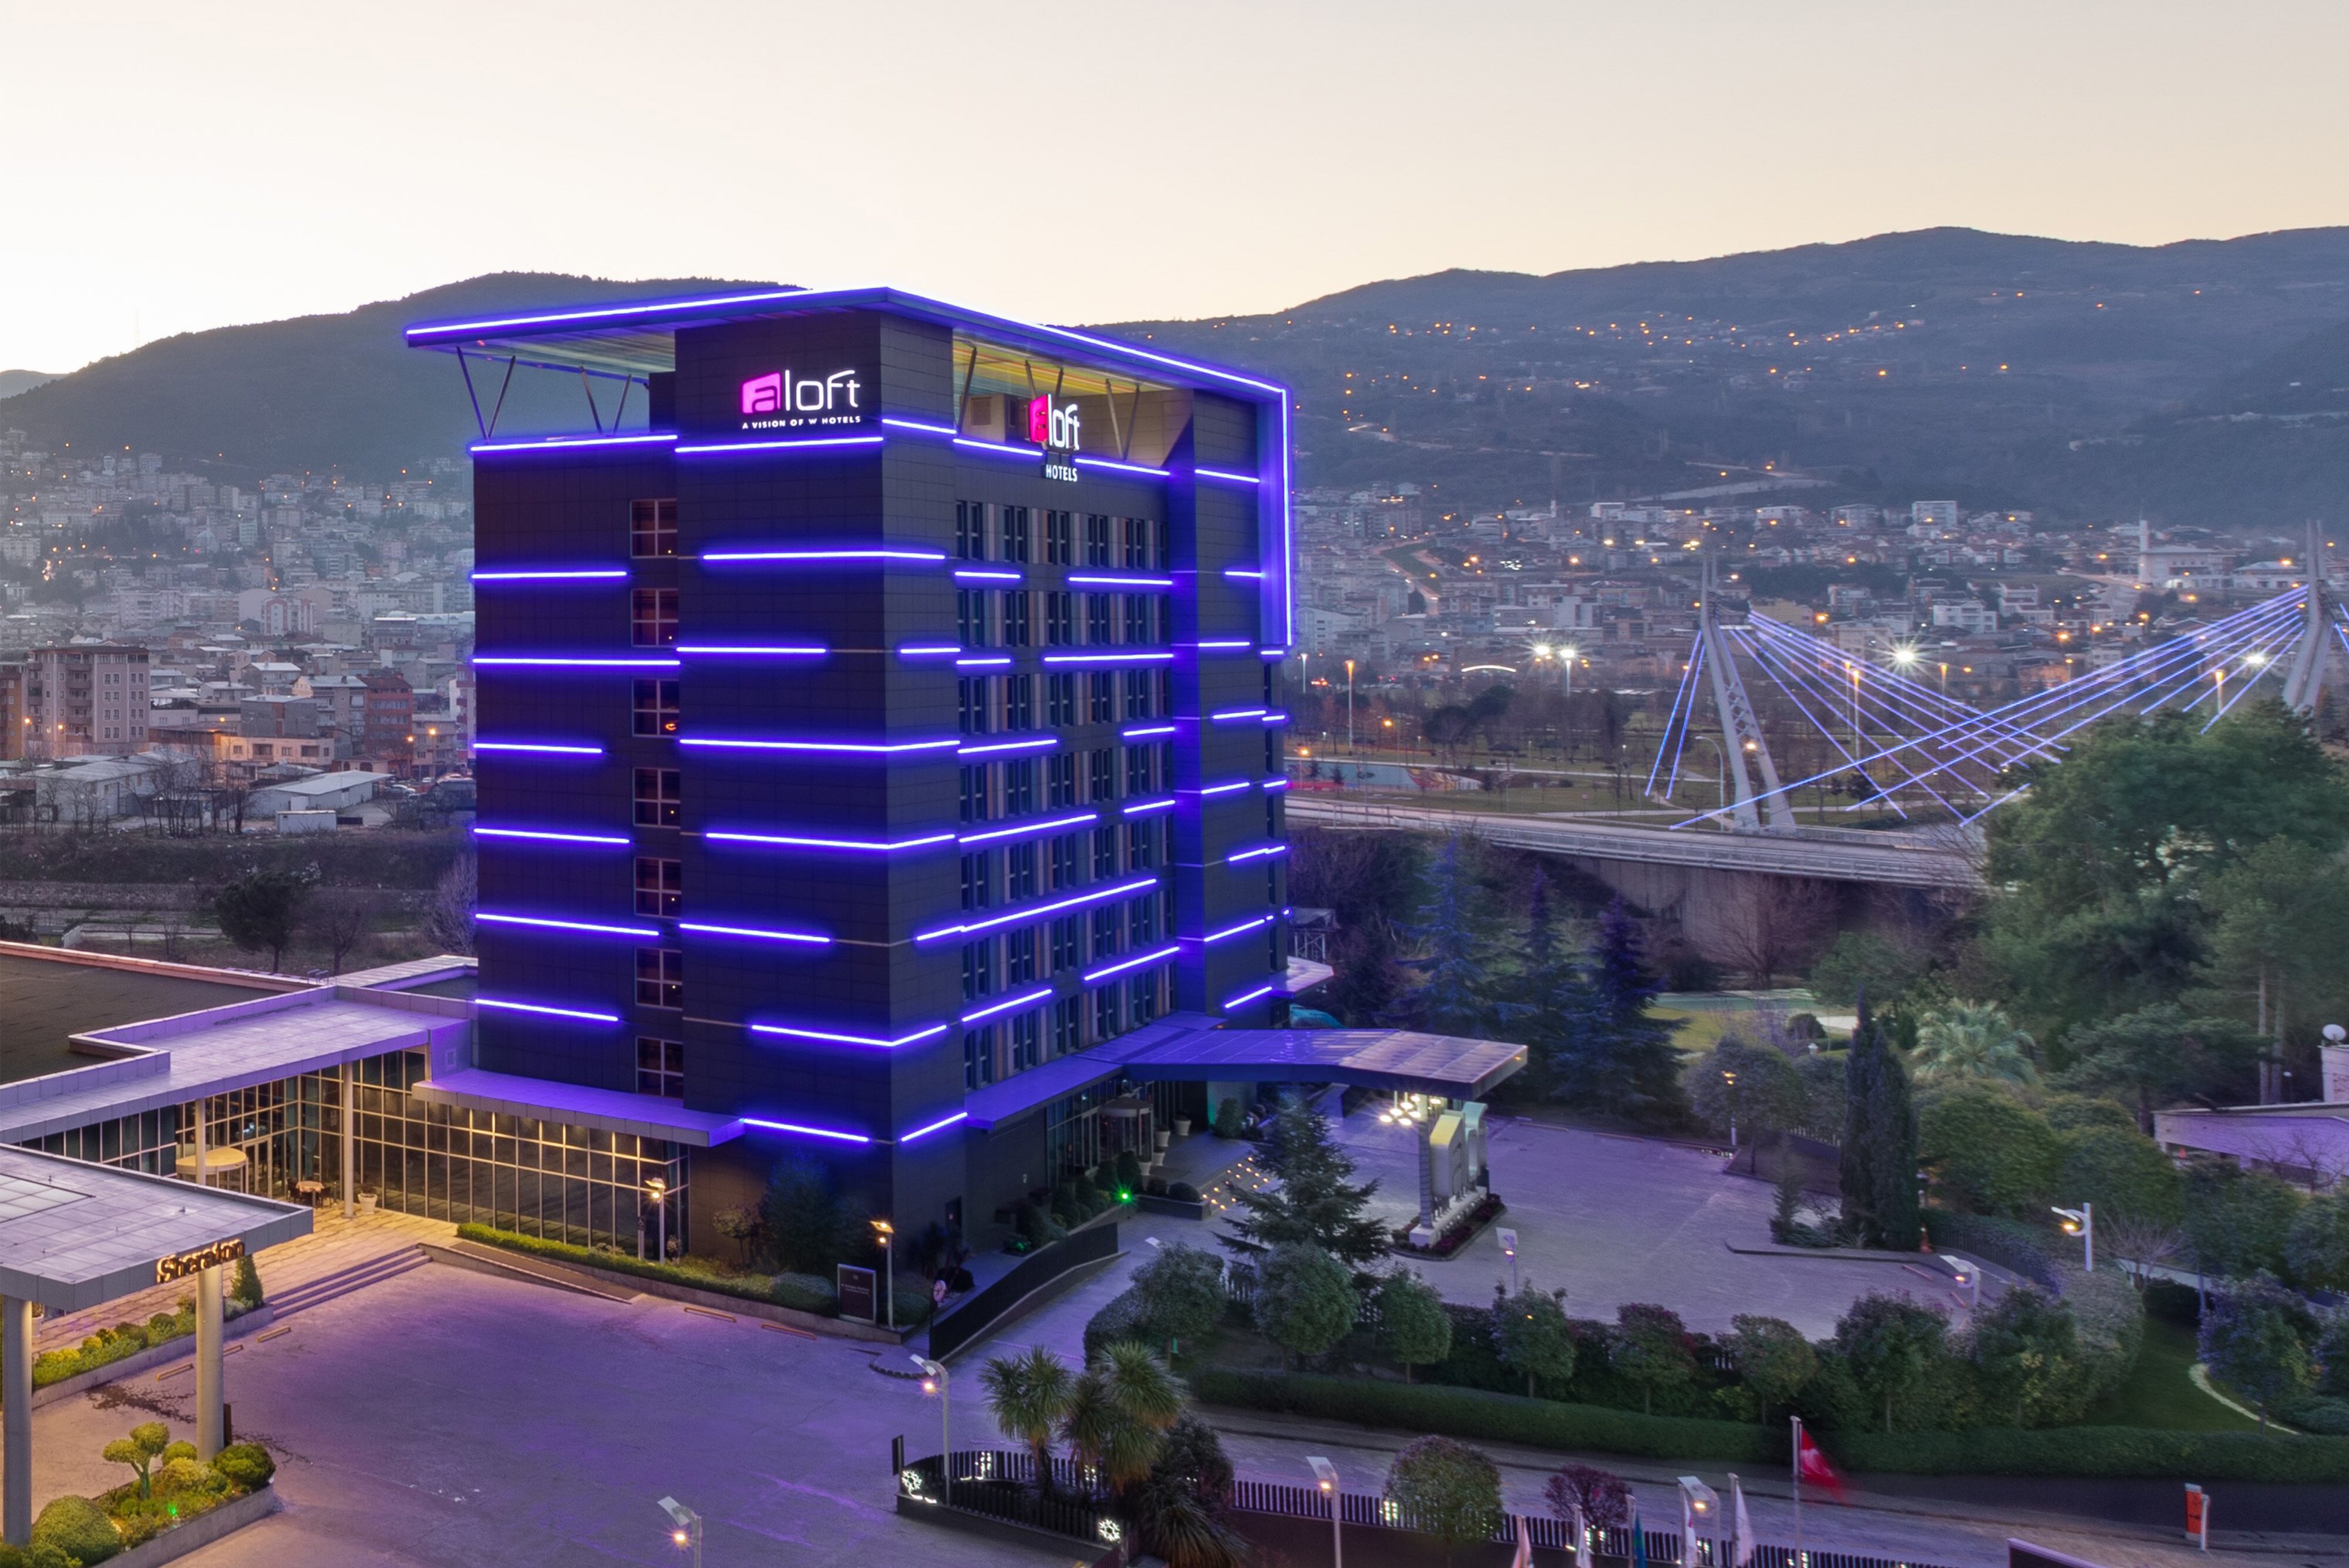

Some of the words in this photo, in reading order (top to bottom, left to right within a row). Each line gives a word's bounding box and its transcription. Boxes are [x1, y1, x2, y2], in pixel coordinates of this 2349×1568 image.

[742, 369, 860, 413] aloft
[752, 420, 786, 429] VISION
[790, 418, 804, 426] OF
[822, 416, 861, 424] HOTELS
[1029, 393, 1079, 450] aloft
[1045, 464, 1078, 482] HOTELS
[156, 1239, 245, 1284] Sheraton
